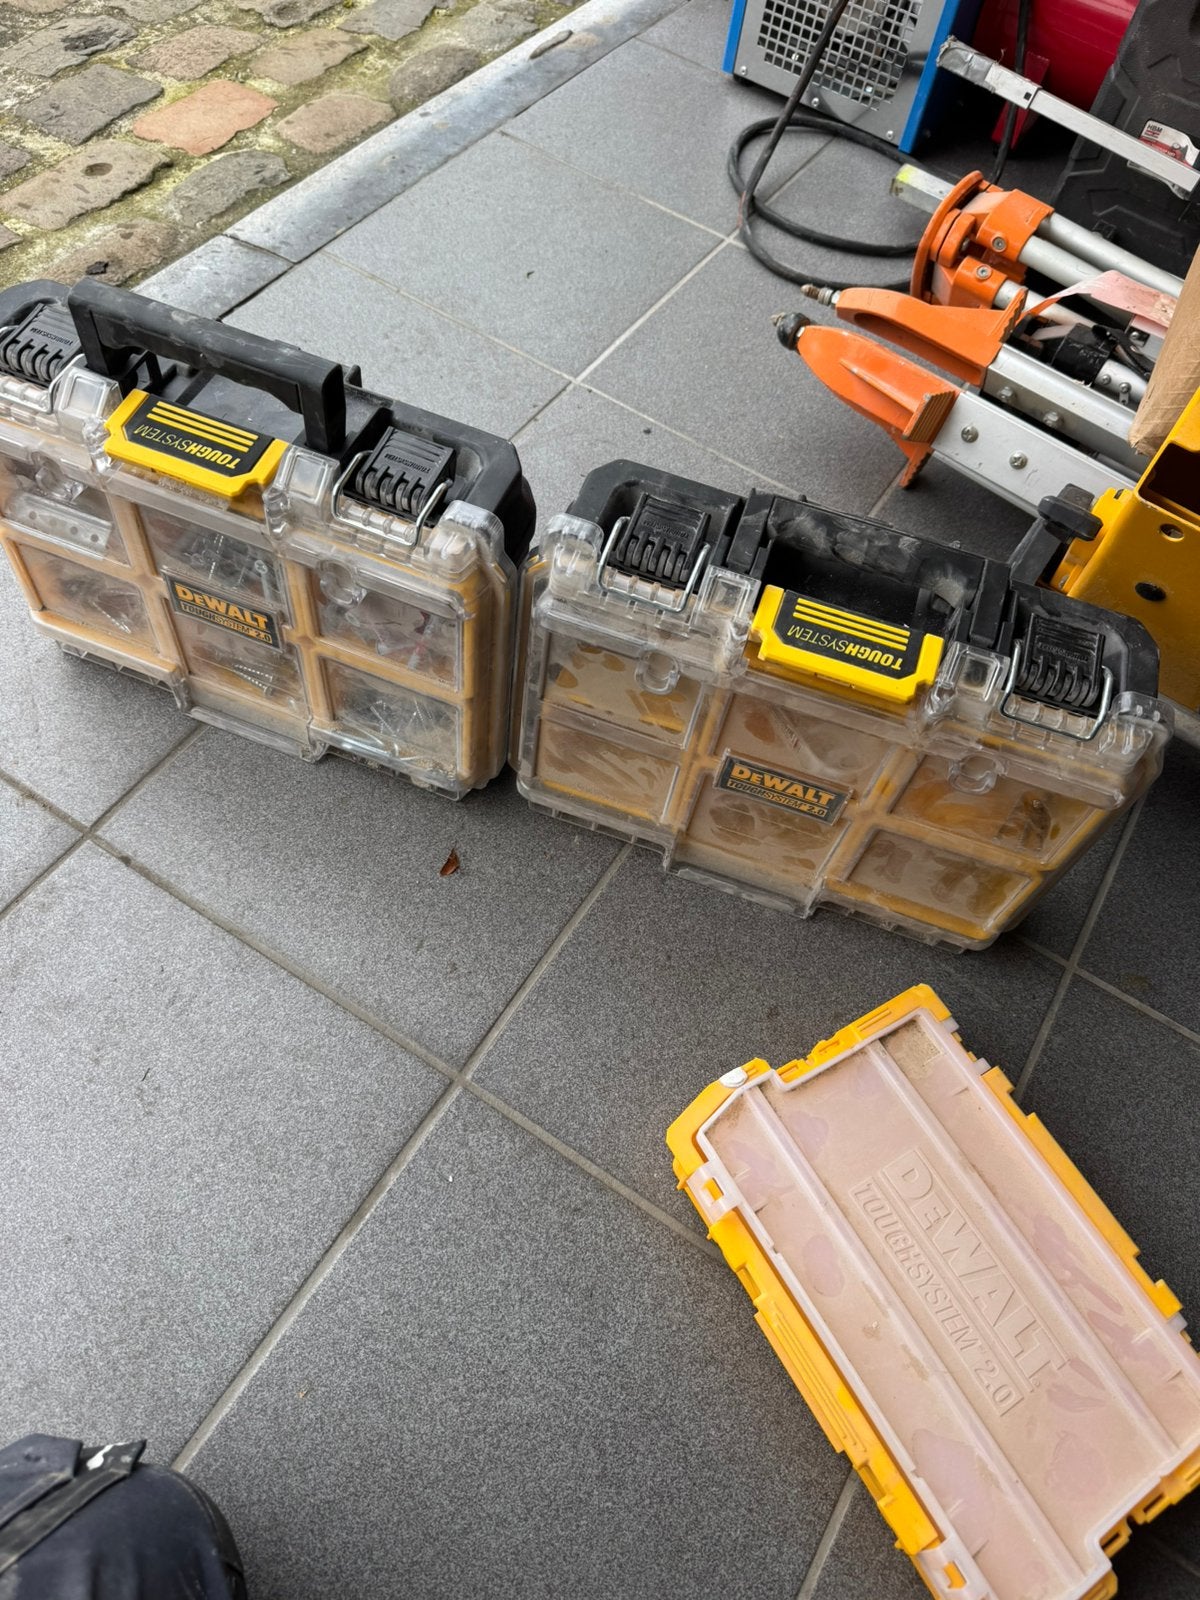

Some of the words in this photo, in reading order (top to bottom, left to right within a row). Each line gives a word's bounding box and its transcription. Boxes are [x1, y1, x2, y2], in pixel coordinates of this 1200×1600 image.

[1147, 124, 1163, 132] HBM
[133, 423, 241, 470] TOUGHSYSTEM
[175, 583, 268, 630] DEWALT
[254, 629, 272, 643] 2.0
[787, 624, 904, 671] TOUGHSYSTEM
[730, 764, 835, 805] DEWALT
[807, 805, 825, 817] 2.0
[973, 1358, 1016, 1409] 2.0
